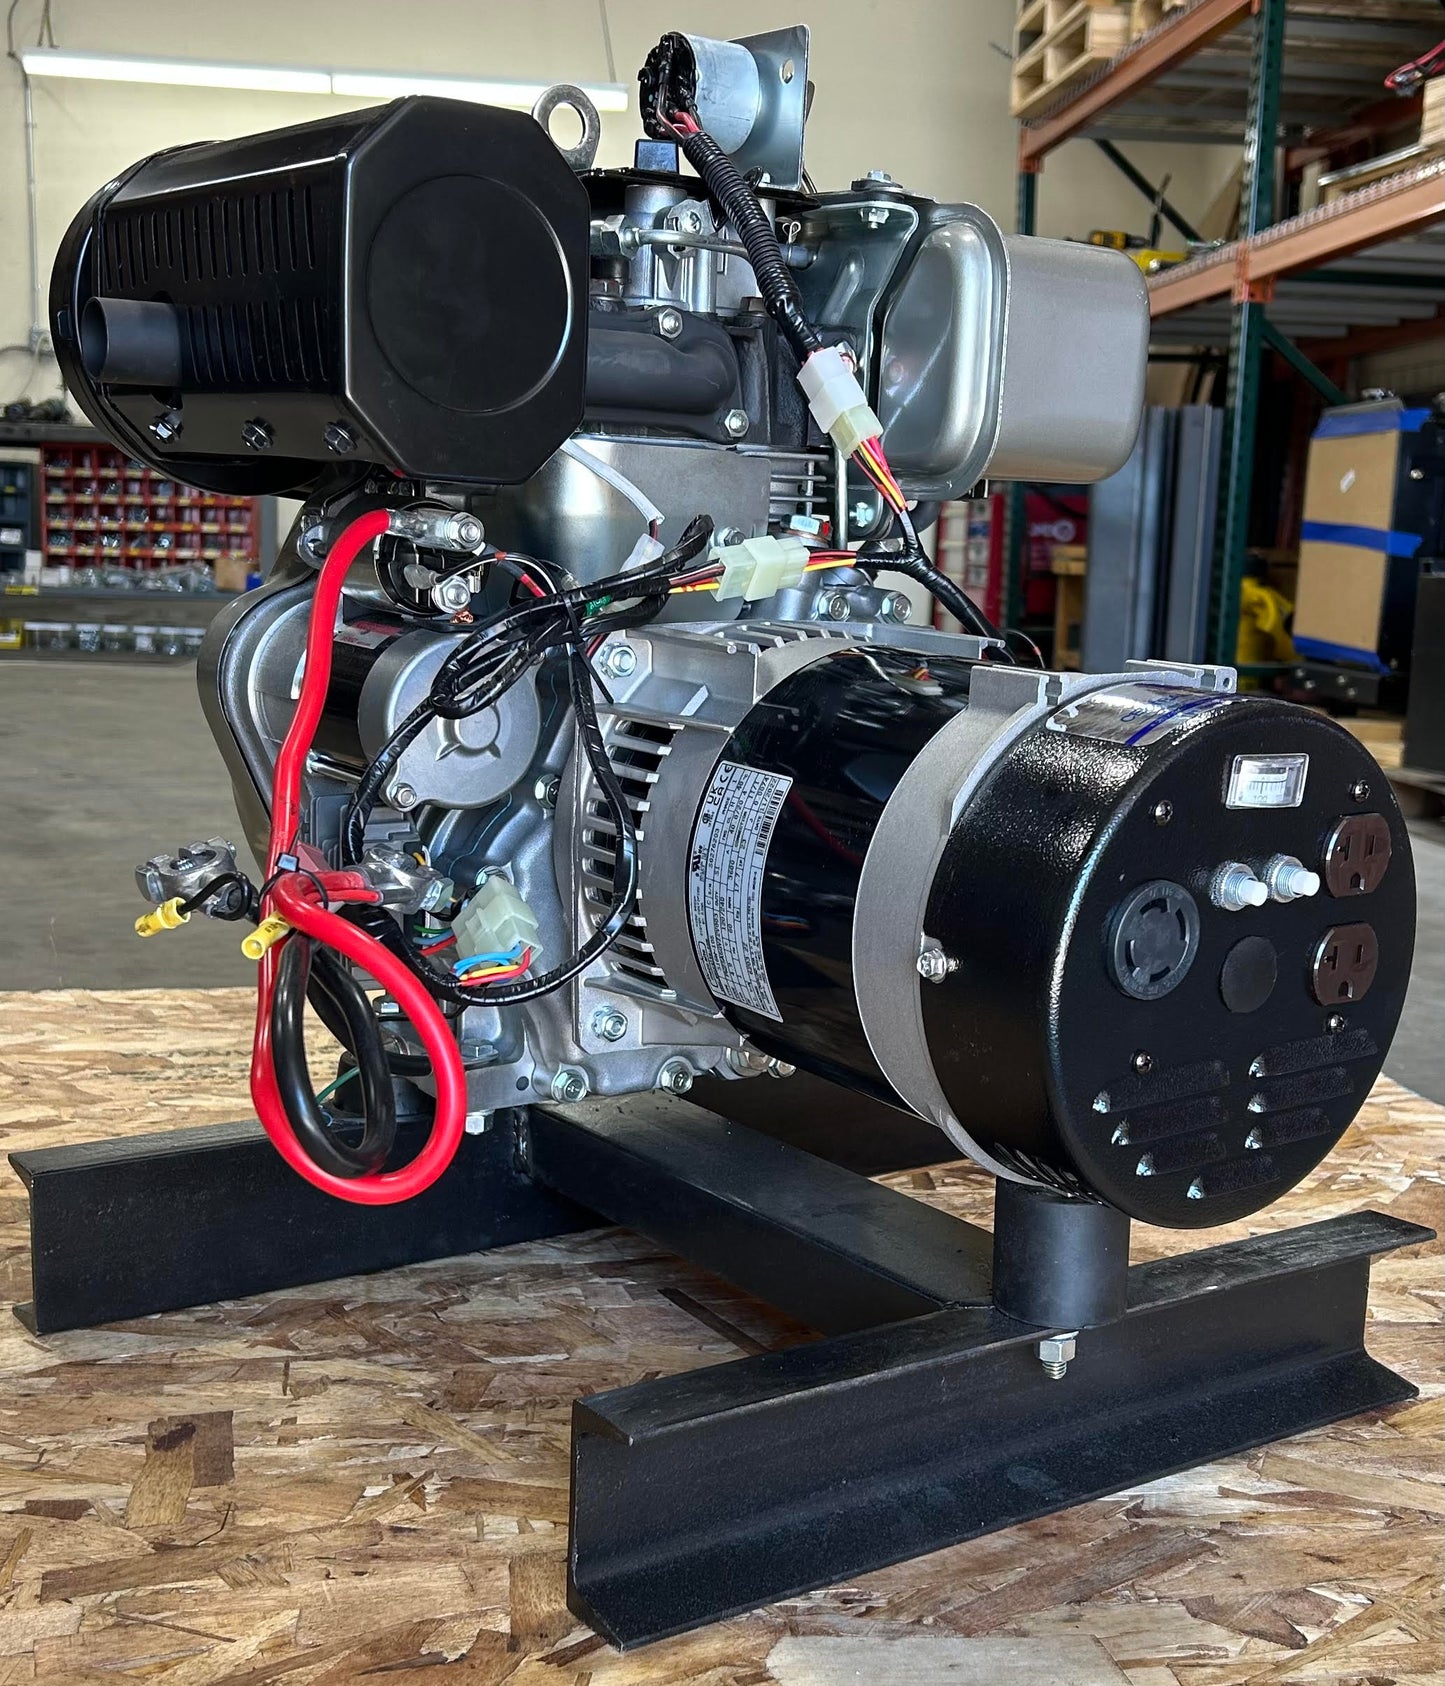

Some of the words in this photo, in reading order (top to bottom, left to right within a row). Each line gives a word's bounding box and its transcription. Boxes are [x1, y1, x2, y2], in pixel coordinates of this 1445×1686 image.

[719, 764, 733, 783] CE
[706, 785, 718, 804] UK
[713, 787, 725, 806] CA
[760, 778, 777, 812] 11/2022
